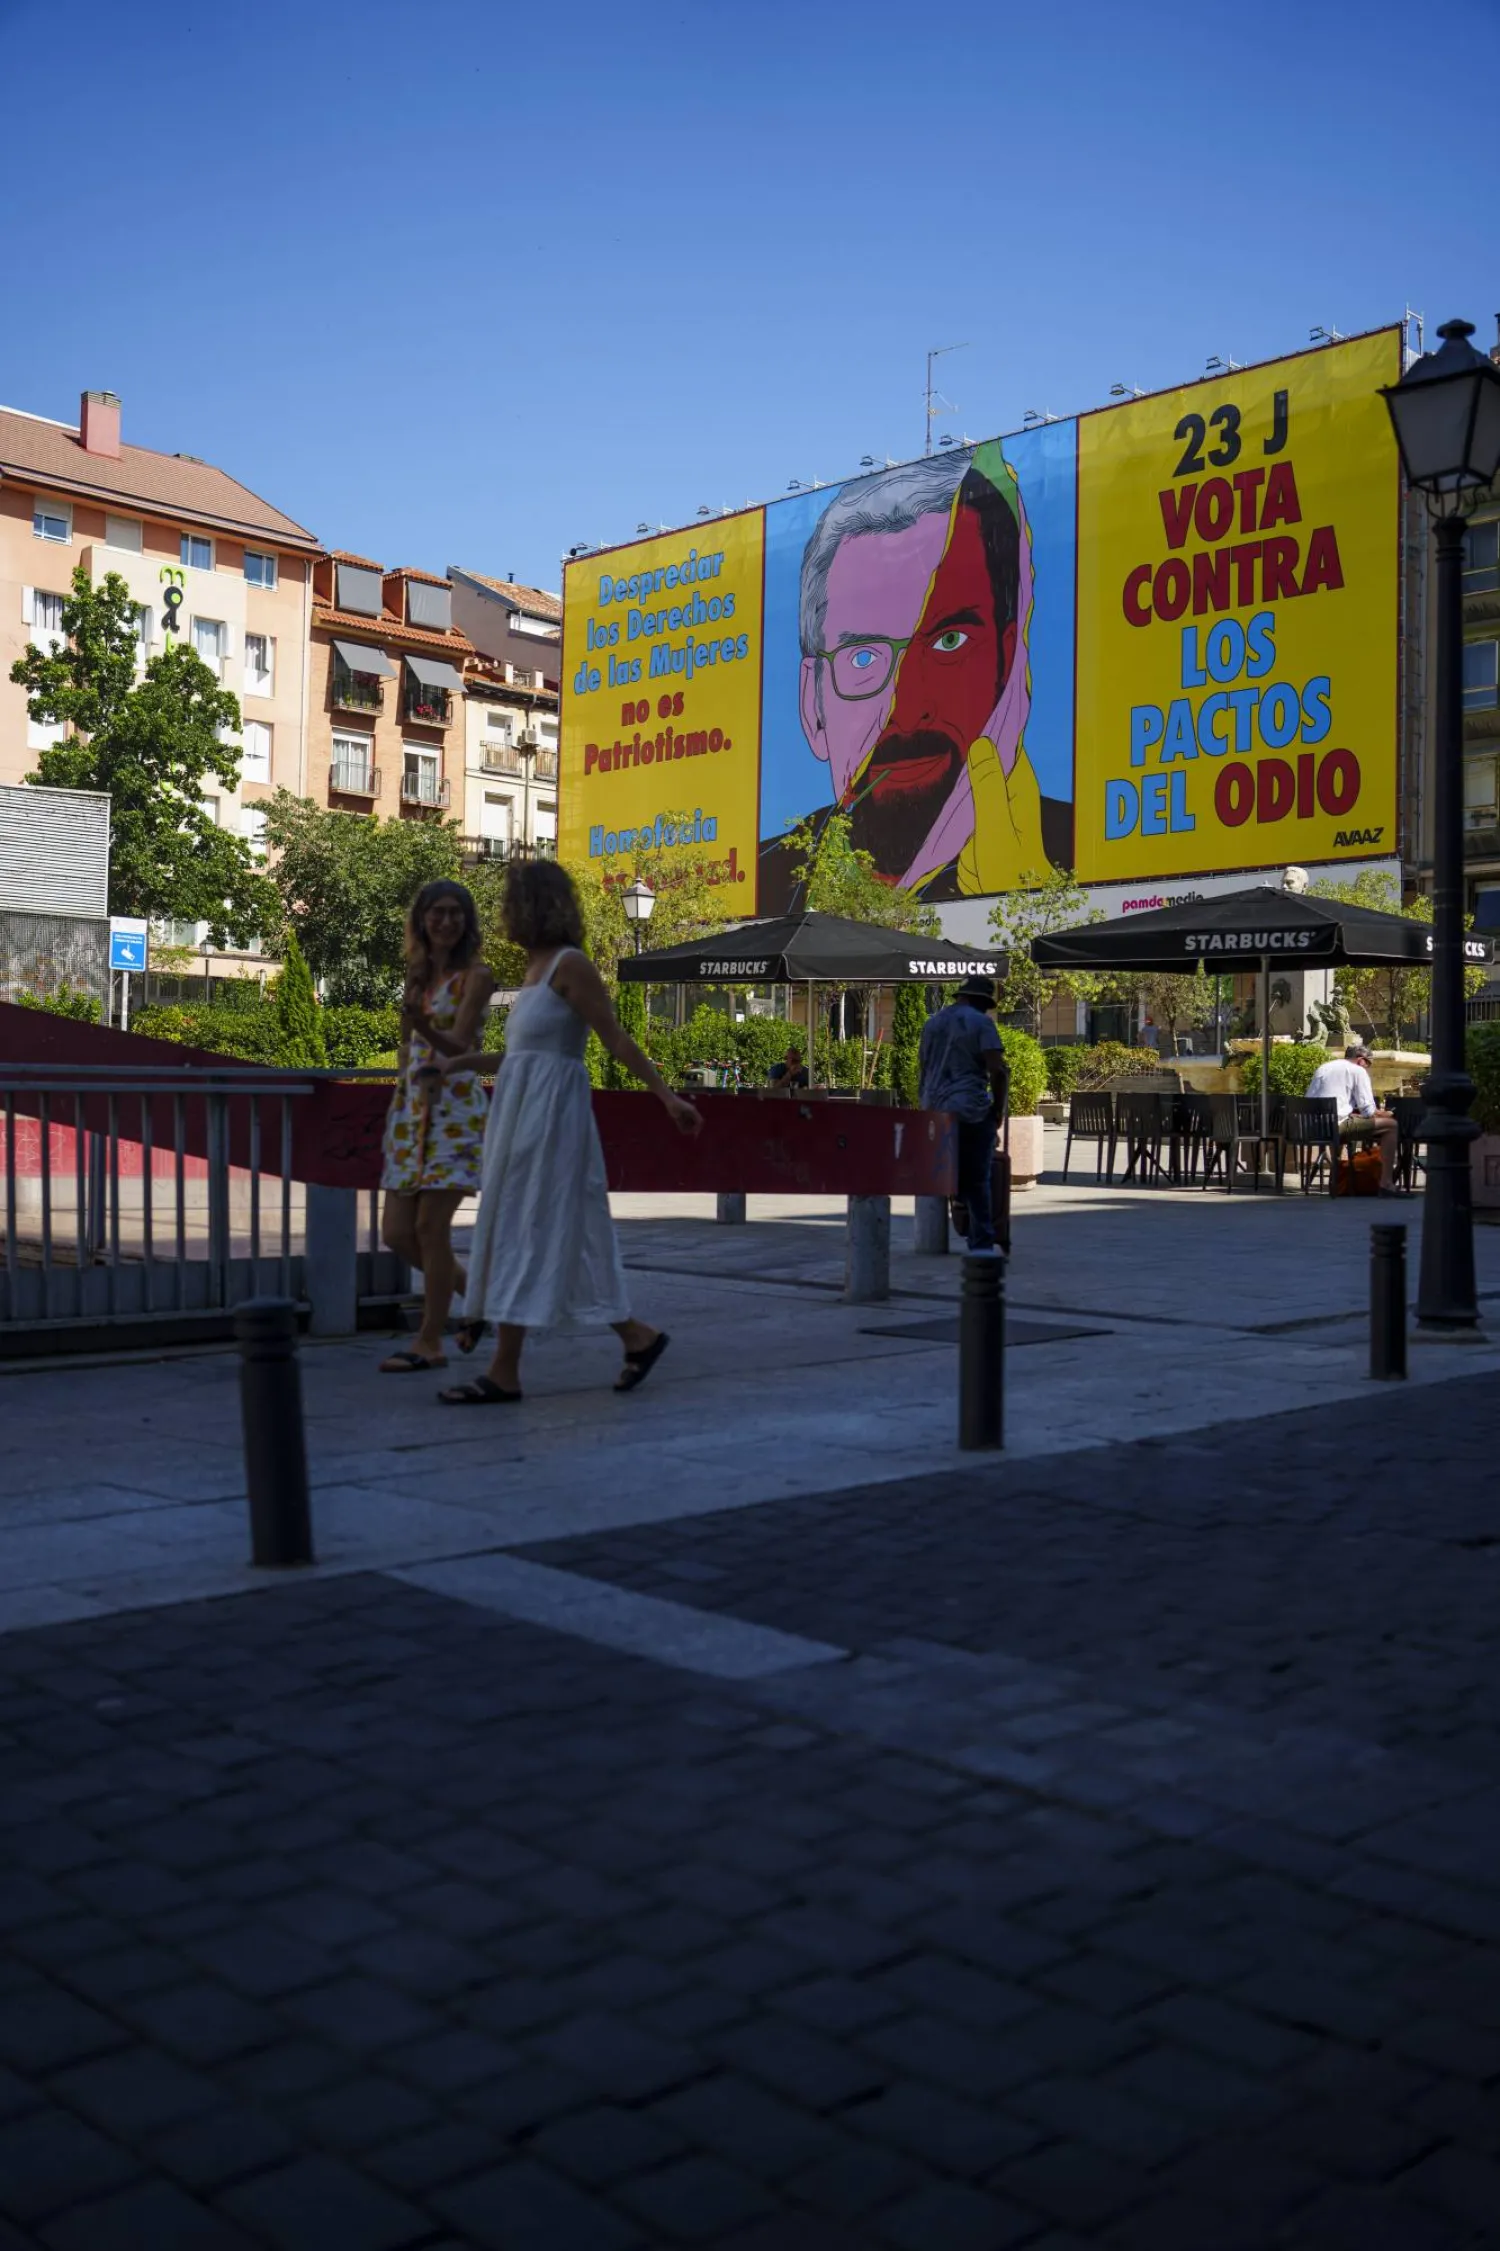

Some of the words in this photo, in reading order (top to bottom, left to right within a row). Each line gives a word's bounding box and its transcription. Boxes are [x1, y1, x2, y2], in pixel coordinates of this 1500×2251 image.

[1172, 403, 1242, 478] 23
[1263, 389, 1289, 455] J
[1158, 460, 1302, 550] VOTA
[598, 549, 725, 607] Despreciar
[1122, 525, 1345, 628] CONTRA
[586, 617, 620, 651] los
[627, 591, 736, 641] Derechos
[1181, 611, 1277, 689] LOS
[574, 661, 602, 695] de
[608, 654, 643, 688] las
[649, 633, 749, 679] Mujeres
[621, 699, 651, 727] no
[657, 691, 685, 718] es
[1130, 675, 1332, 768] PACTOS
[584, 726, 732, 776] Patriotismo.
[1105, 770, 1196, 841] DEL
[1214, 748, 1361, 828] ODIO
[1333, 827, 1384, 847] AVAAZ
[700, 960, 768, 975] STARBUCKS
[909, 960, 997, 975] STARBUCKS
[1185, 931, 1312, 950] STARBUCKS
